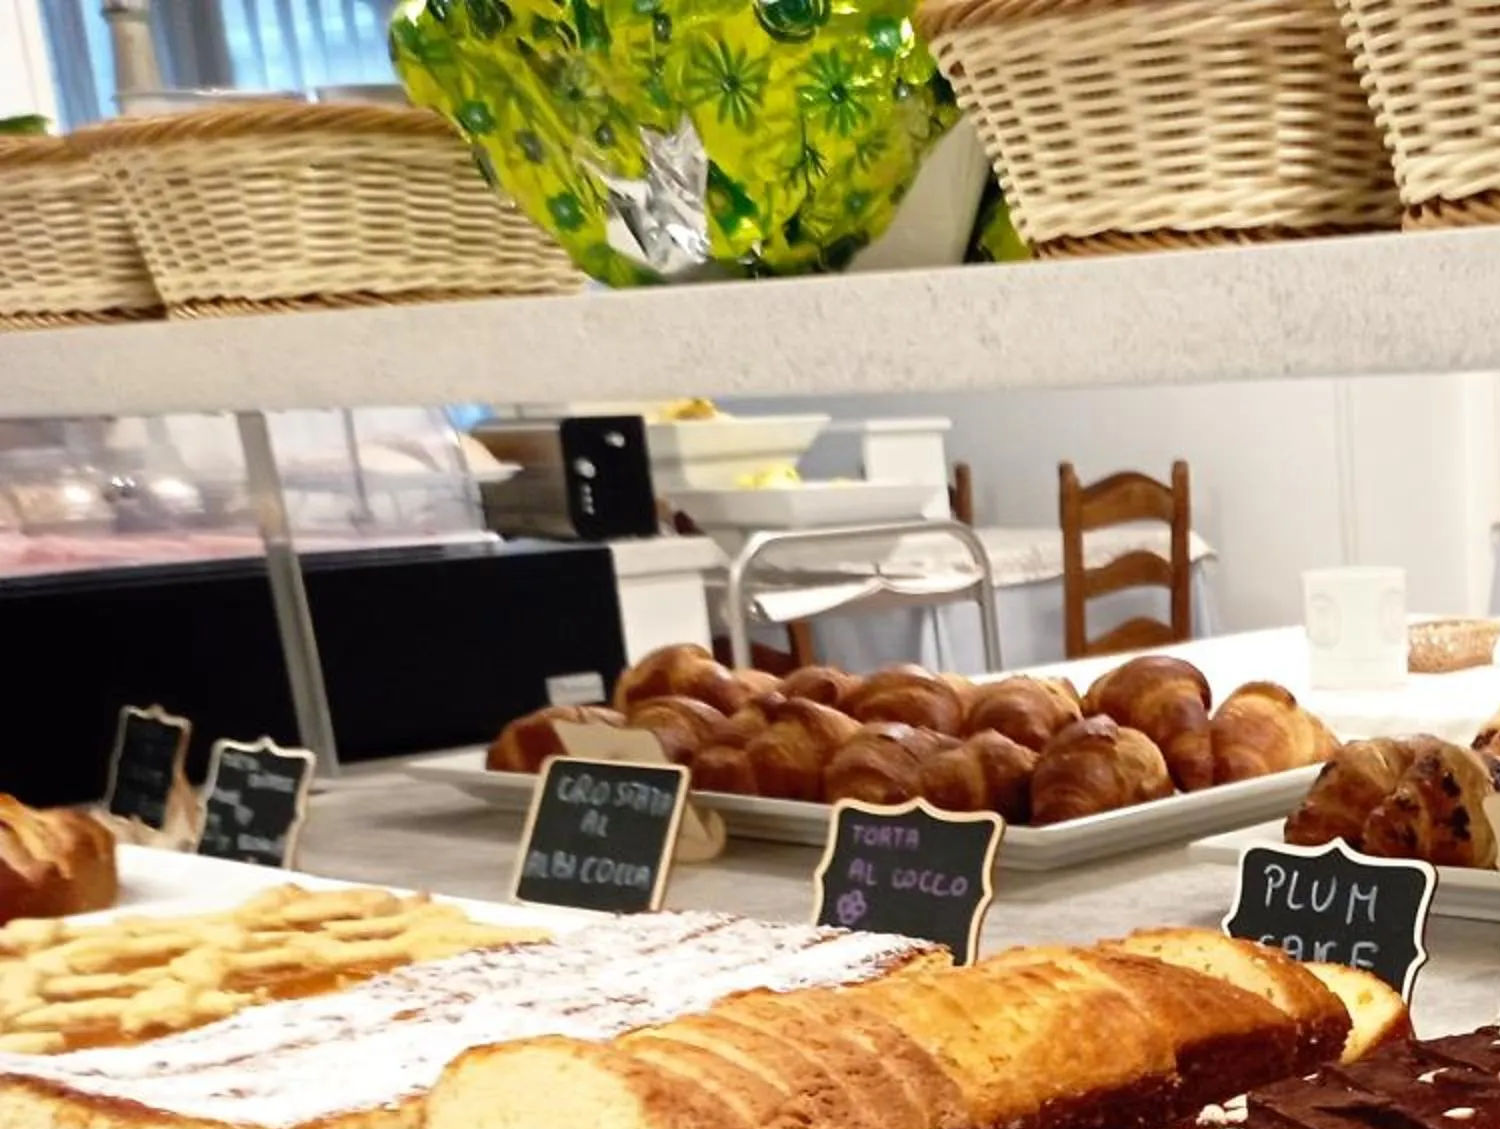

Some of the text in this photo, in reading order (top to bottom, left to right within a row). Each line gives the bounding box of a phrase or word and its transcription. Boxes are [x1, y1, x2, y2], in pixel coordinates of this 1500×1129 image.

[852, 824, 920, 849] TORTA
[848, 858, 969, 897] AL COCCO
[1263, 863, 1379, 925] PLUM
